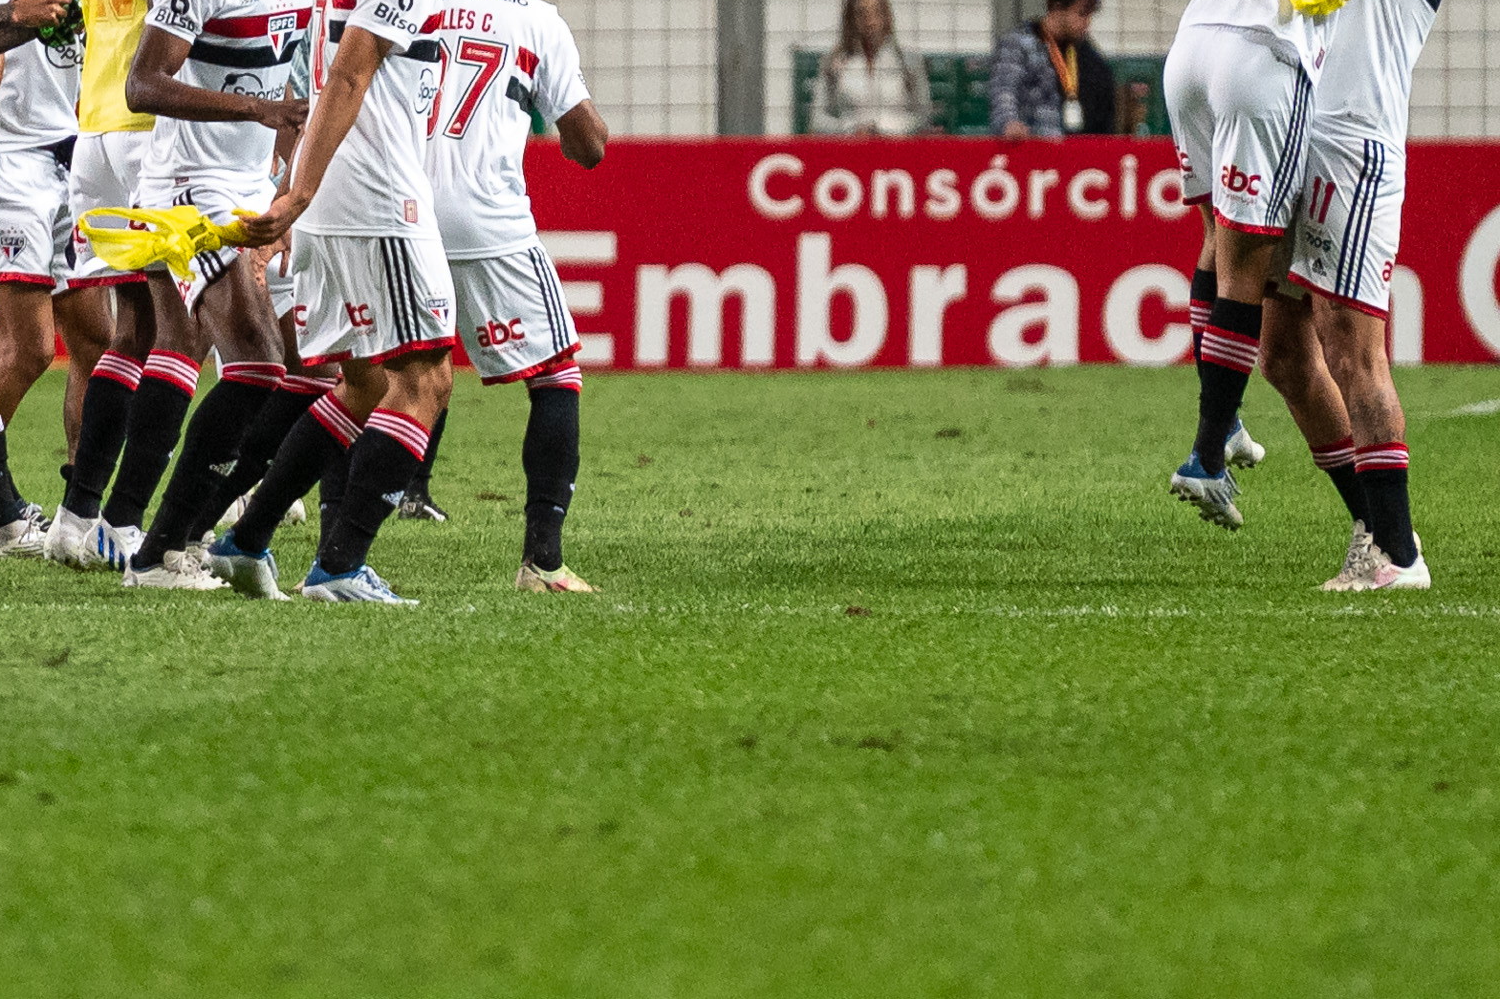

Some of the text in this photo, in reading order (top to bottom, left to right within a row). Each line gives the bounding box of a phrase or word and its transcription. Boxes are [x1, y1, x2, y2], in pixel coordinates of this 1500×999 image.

[154, 8, 196, 32] Bitso
[270, 17, 294, 31] SPFC
[374, 2, 417, 35] Bitso
[440, 8, 496, 34] LLES C.
[747, 151, 1198, 221] Consórcio
[1221, 164, 1262, 196] abc
[1309, 176, 1335, 224] 11
[476, 317, 525, 348] abc
